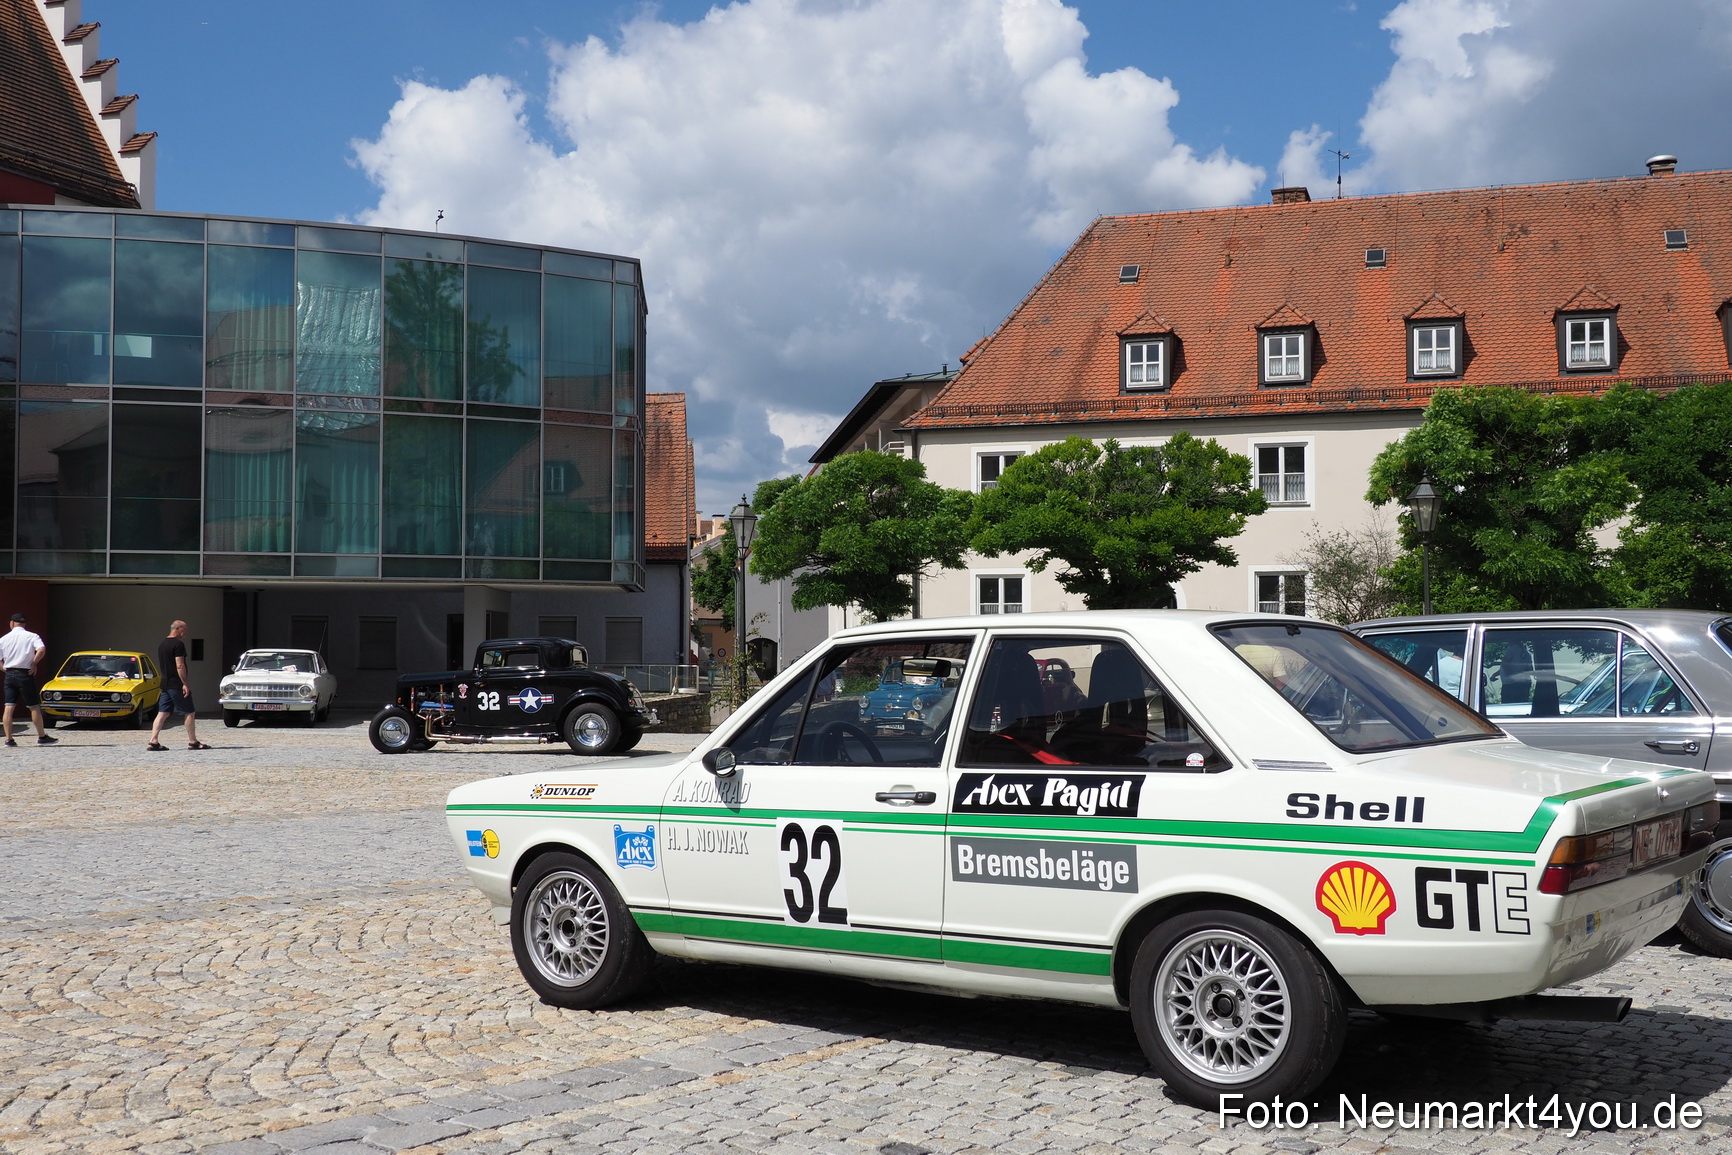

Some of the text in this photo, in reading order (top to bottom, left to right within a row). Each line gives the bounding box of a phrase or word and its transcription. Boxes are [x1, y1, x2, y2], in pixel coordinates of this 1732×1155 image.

[477, 691, 500, 711] 32
[544, 787, 596, 796] DUNLOP
[671, 779, 752, 804] A. KONRAD
[1041, 778, 1132, 815] Pagid
[1286, 792, 1425, 823] Shell
[696, 827, 749, 855] NOWAK
[780, 822, 848, 925] 32
[957, 844, 1130, 891] Bremsbeläge
[1415, 866, 1531, 935] GTE
